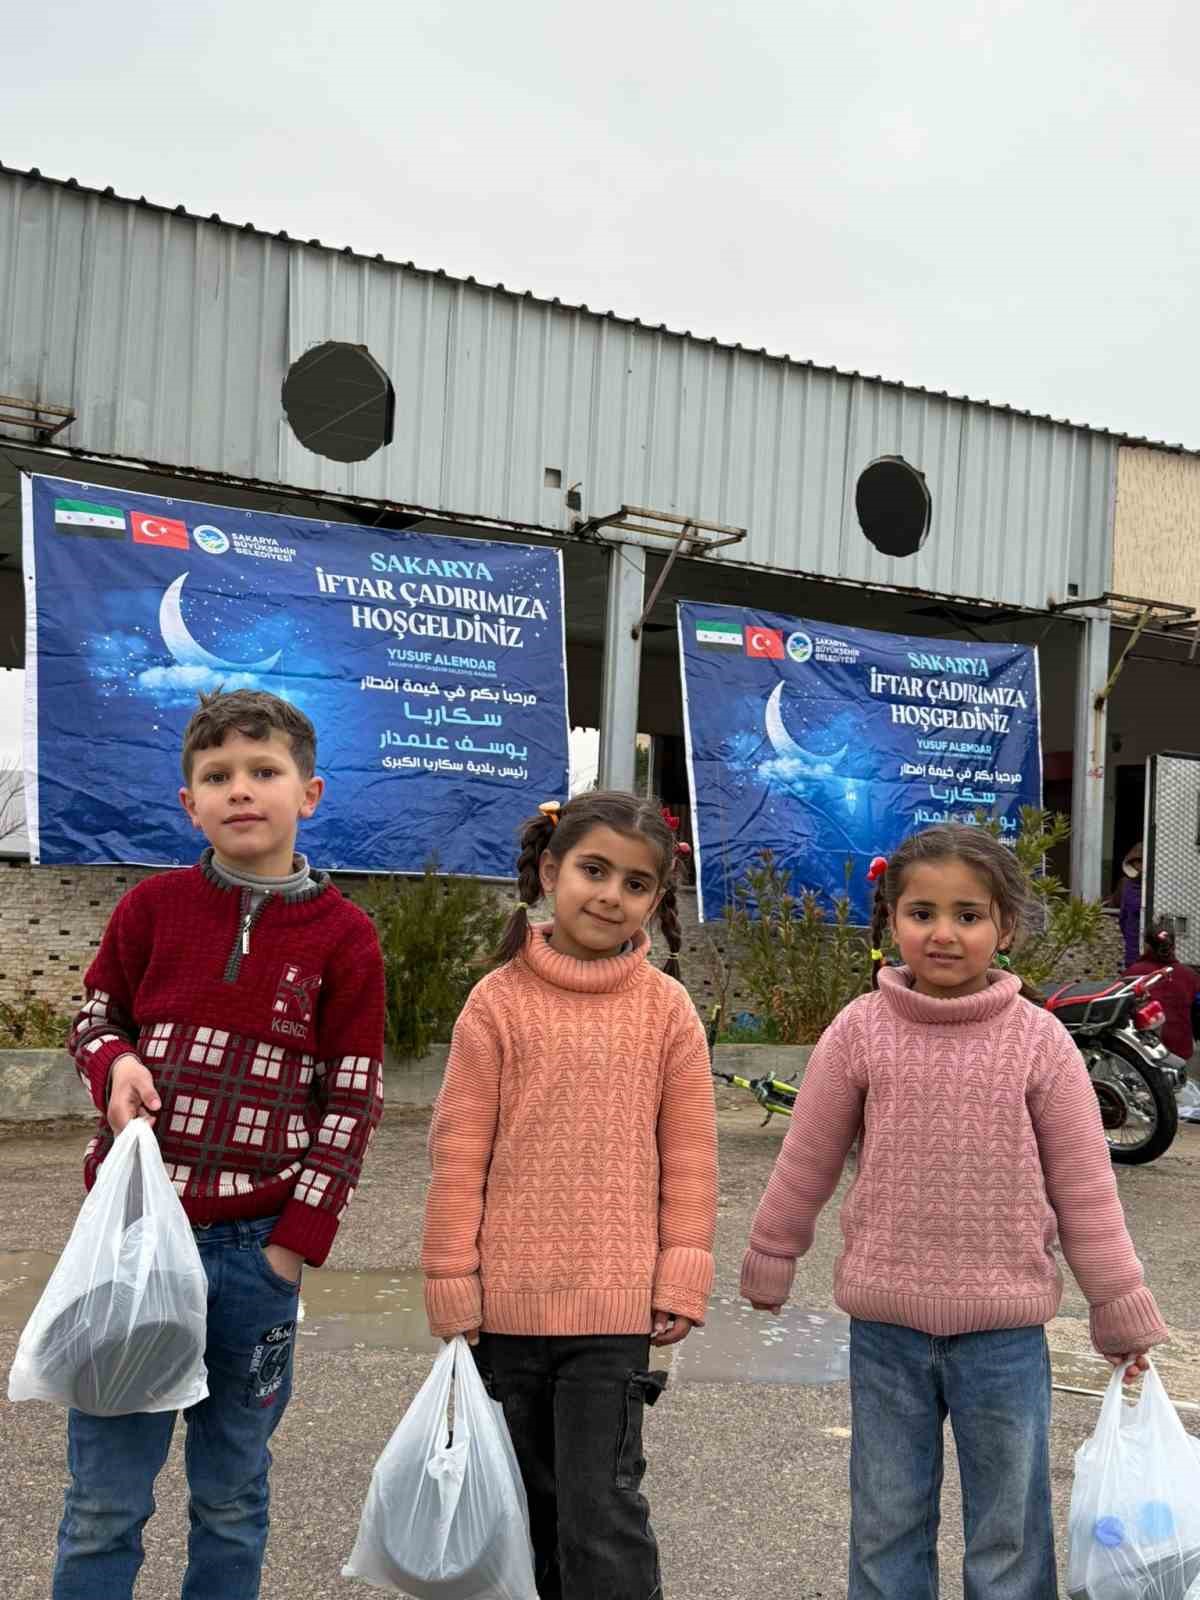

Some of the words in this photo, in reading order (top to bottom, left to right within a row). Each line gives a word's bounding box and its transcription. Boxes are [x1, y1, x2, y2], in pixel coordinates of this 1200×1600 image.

[231, 532, 279, 546] SAKARYA
[369, 551, 494, 582] SAKARYA
[315, 566, 397, 601] İFTAR
[399, 582, 548, 620] ÇADIRIMIZA
[351, 605, 524, 648] HOŞGELDİNİZ
[387, 648, 432, 663] YUSUF
[434, 654, 496, 671] ALEMDAR
[907, 652, 990, 678] SAKARYA
[402, 679, 440, 697] خيمة
[443, 685, 466, 701] في
[470, 688, 499, 704] بكم
[870, 666, 923, 698] İFTAR
[926, 679, 1028, 709] ÇADIRIMIZA
[891, 704, 1010, 733] HOŞGELDİNİZ
[379, 729, 449, 750] علمدار
[455, 735, 528, 761] يوسف
[916, 738, 947, 751] YUSUF
[948, 742, 992, 755] ALEMDAR
[423, 758, 463, 771] سكاريا
[466, 760, 496, 776] بلدية
[497, 765, 528, 780] رئيس
[928, 764, 954, 779] خيمة
[956, 767, 971, 782] في
